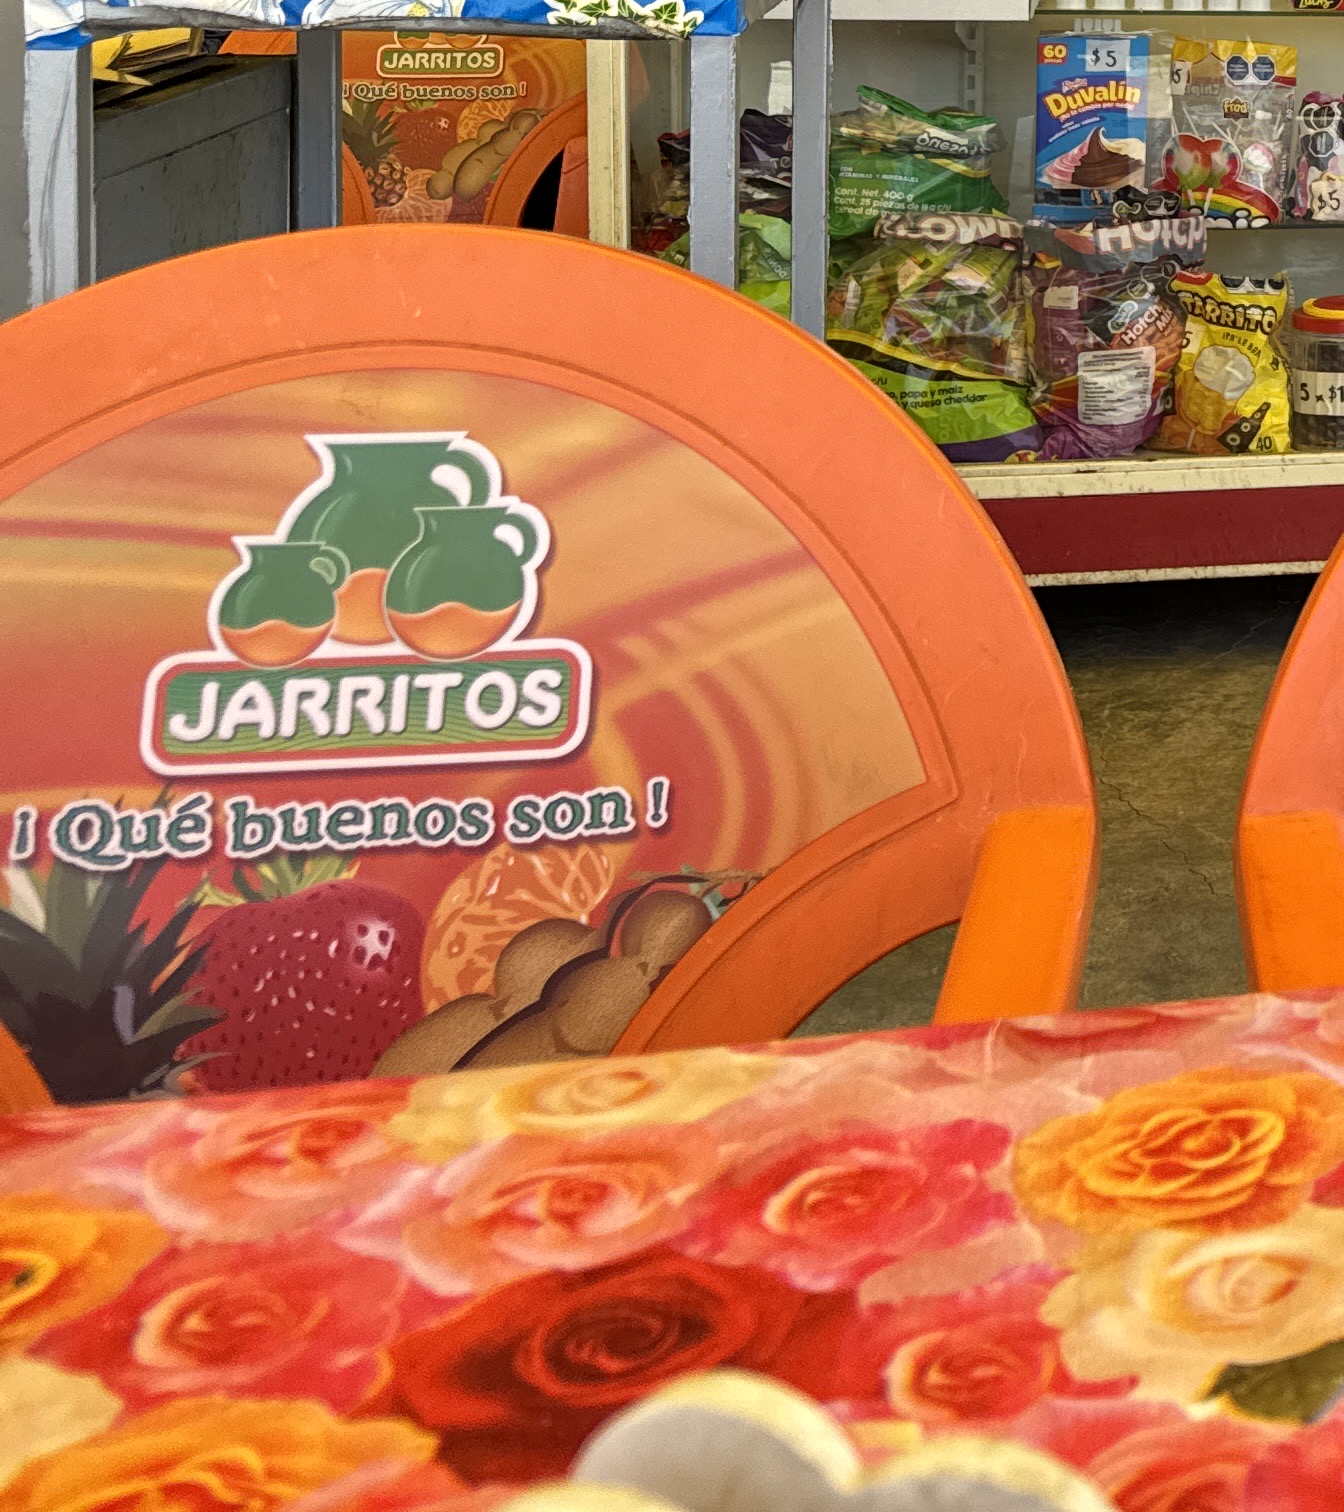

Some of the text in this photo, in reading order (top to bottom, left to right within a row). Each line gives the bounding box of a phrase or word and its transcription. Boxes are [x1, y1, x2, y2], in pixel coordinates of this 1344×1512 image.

[384, 52, 495, 69] JARRITOS
[1042, 46, 1067, 59] 60
[1318, 190, 1340, 210] $5
[902, 394, 988, 410] y queso cheddar
[168, 668, 562, 742] JARRITOS
